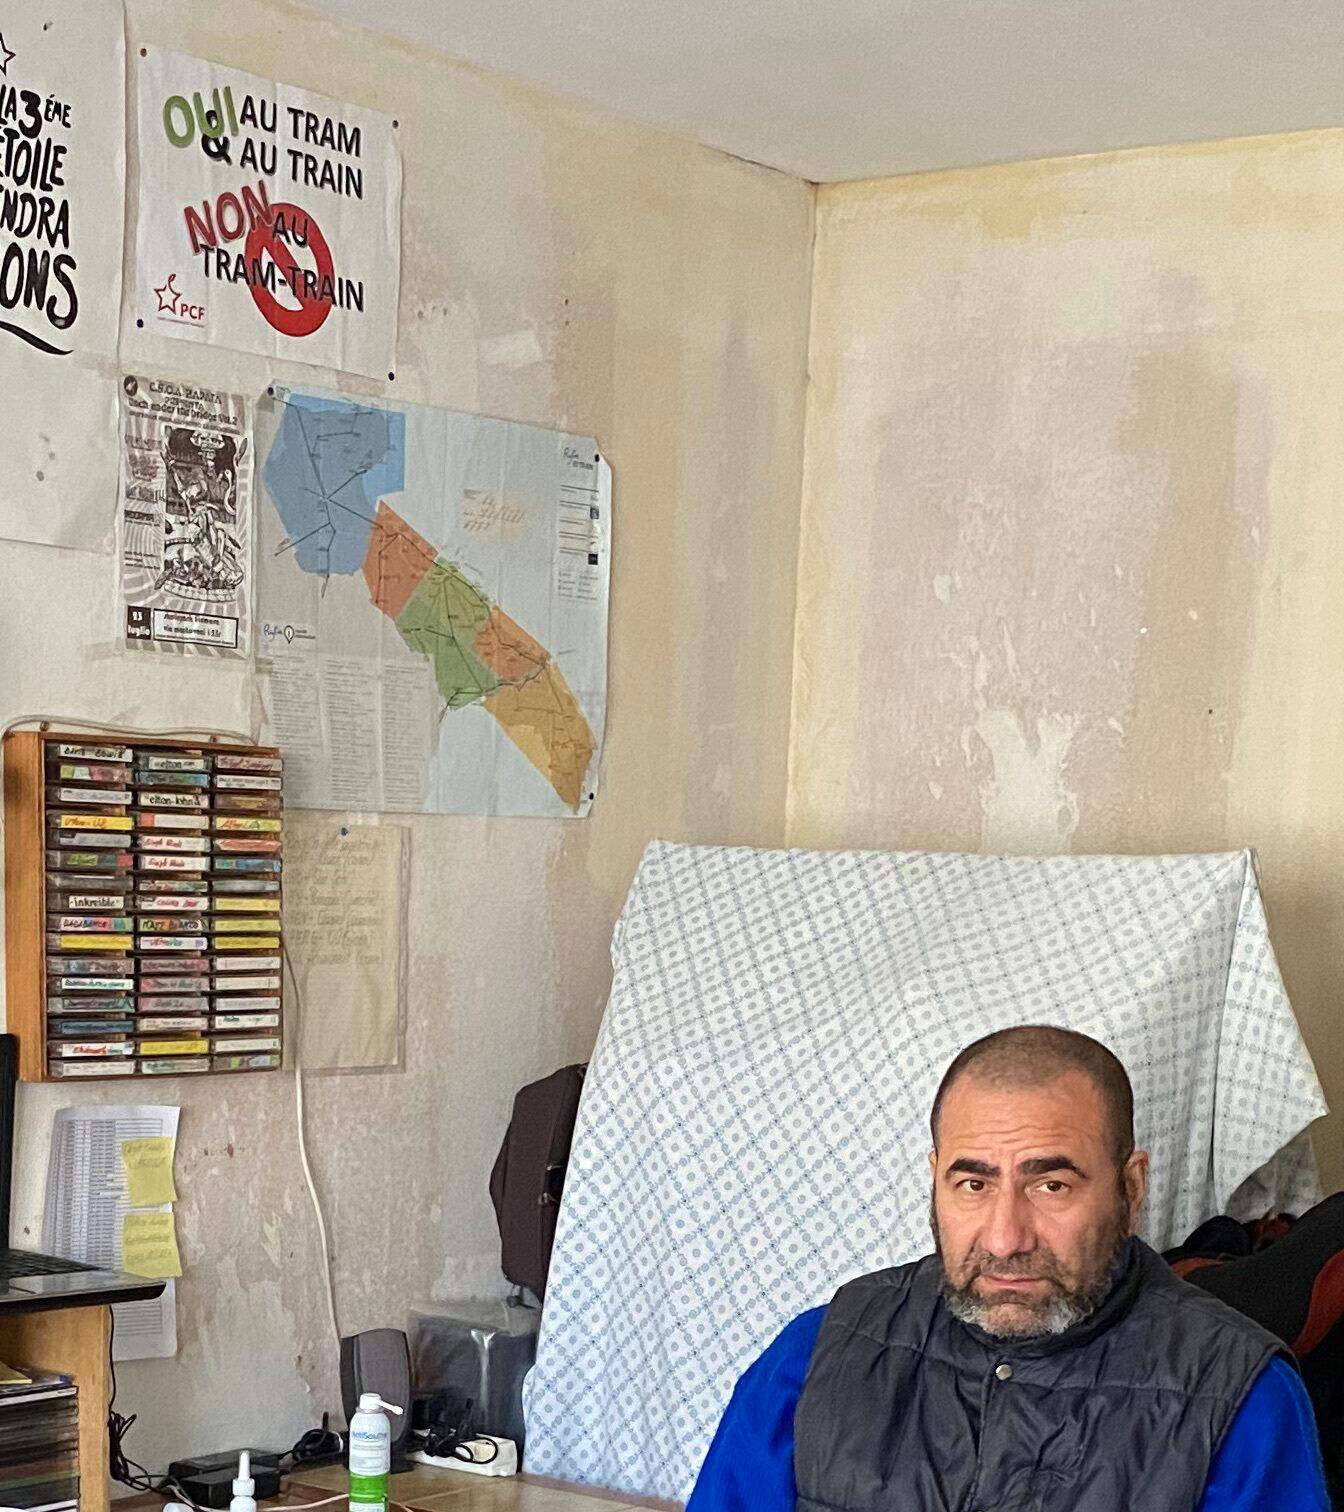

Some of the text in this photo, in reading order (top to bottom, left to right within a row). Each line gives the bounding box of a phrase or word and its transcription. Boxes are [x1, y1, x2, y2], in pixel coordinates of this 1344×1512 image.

[163, 86, 361, 157] OUI AU TRAM
[201, 109, 363, 200] & AU TRAIN
[184, 180, 308, 256] NON AU
[180, 303, 205, 321] PCF
[200, 244, 364, 312] TRAM-TRAIN
